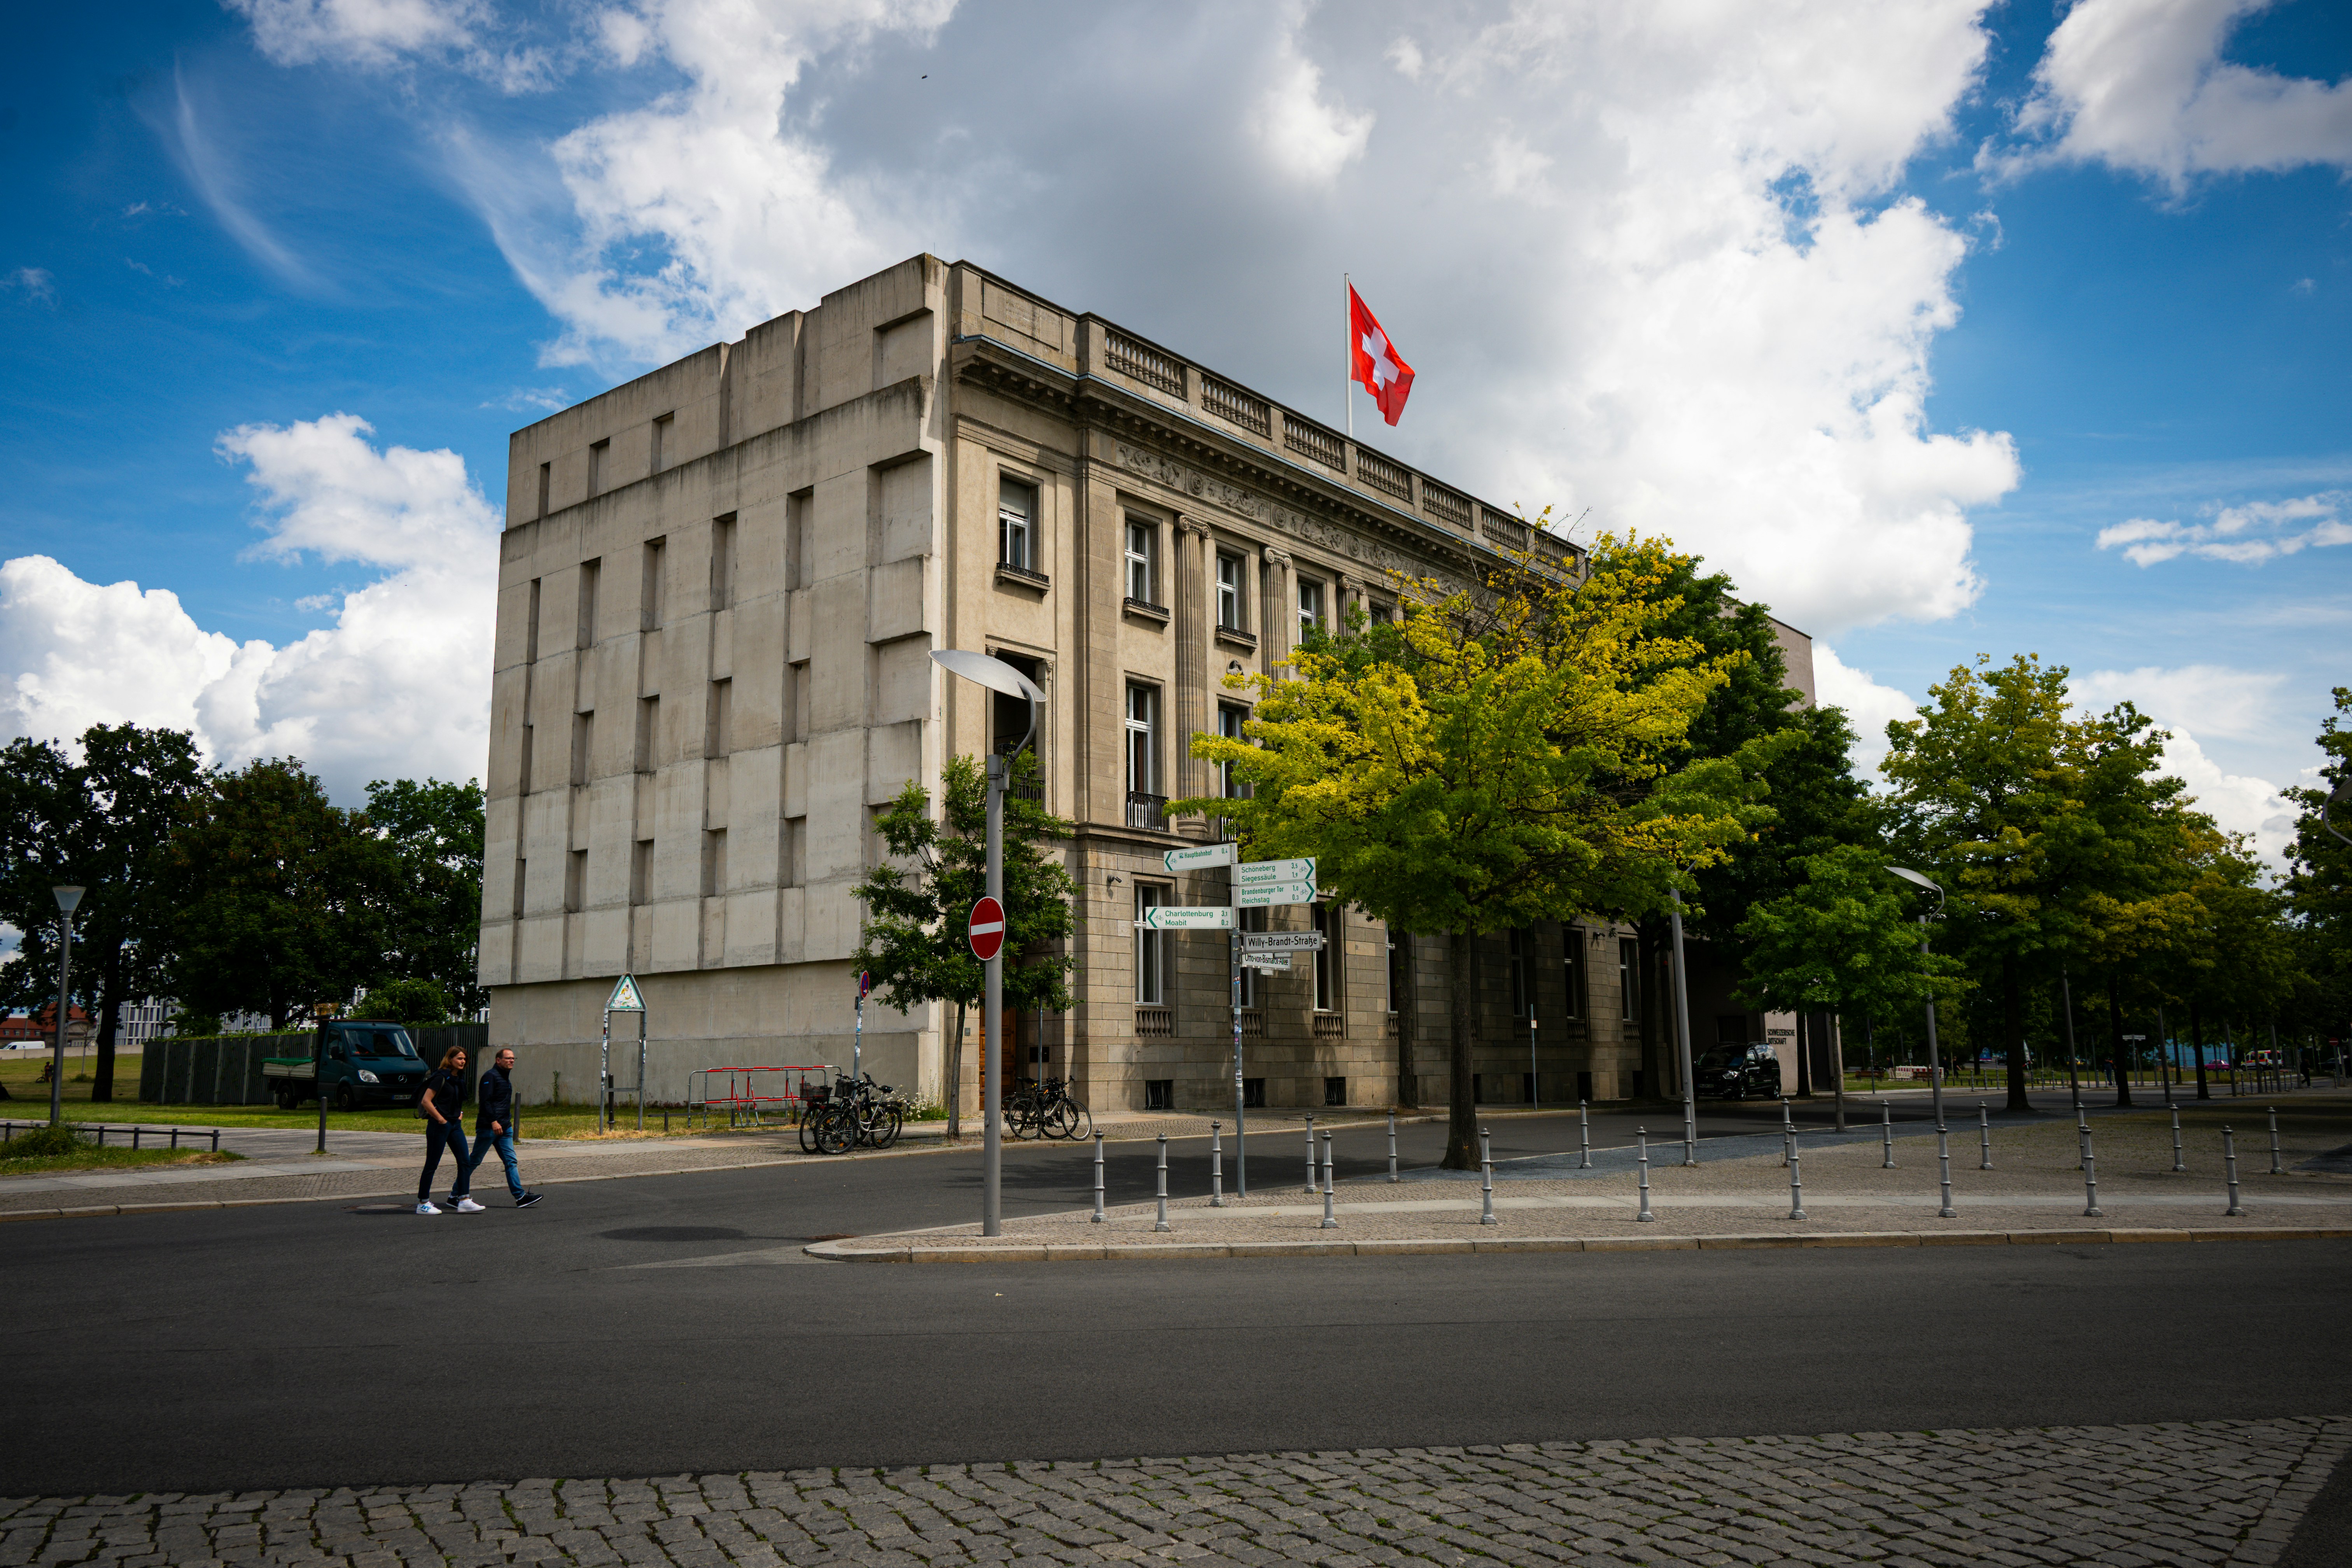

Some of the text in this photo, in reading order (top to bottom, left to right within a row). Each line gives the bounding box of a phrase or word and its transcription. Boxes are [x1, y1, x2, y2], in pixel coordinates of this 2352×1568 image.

[1185, 849, 1212, 859] Hauptbahnhof
[1241, 865, 1276, 873] Schöneberg
[1242, 874, 1276, 882] Siegessäule
[1248, 936, 1317, 948] Willy-Brandt-Straße
